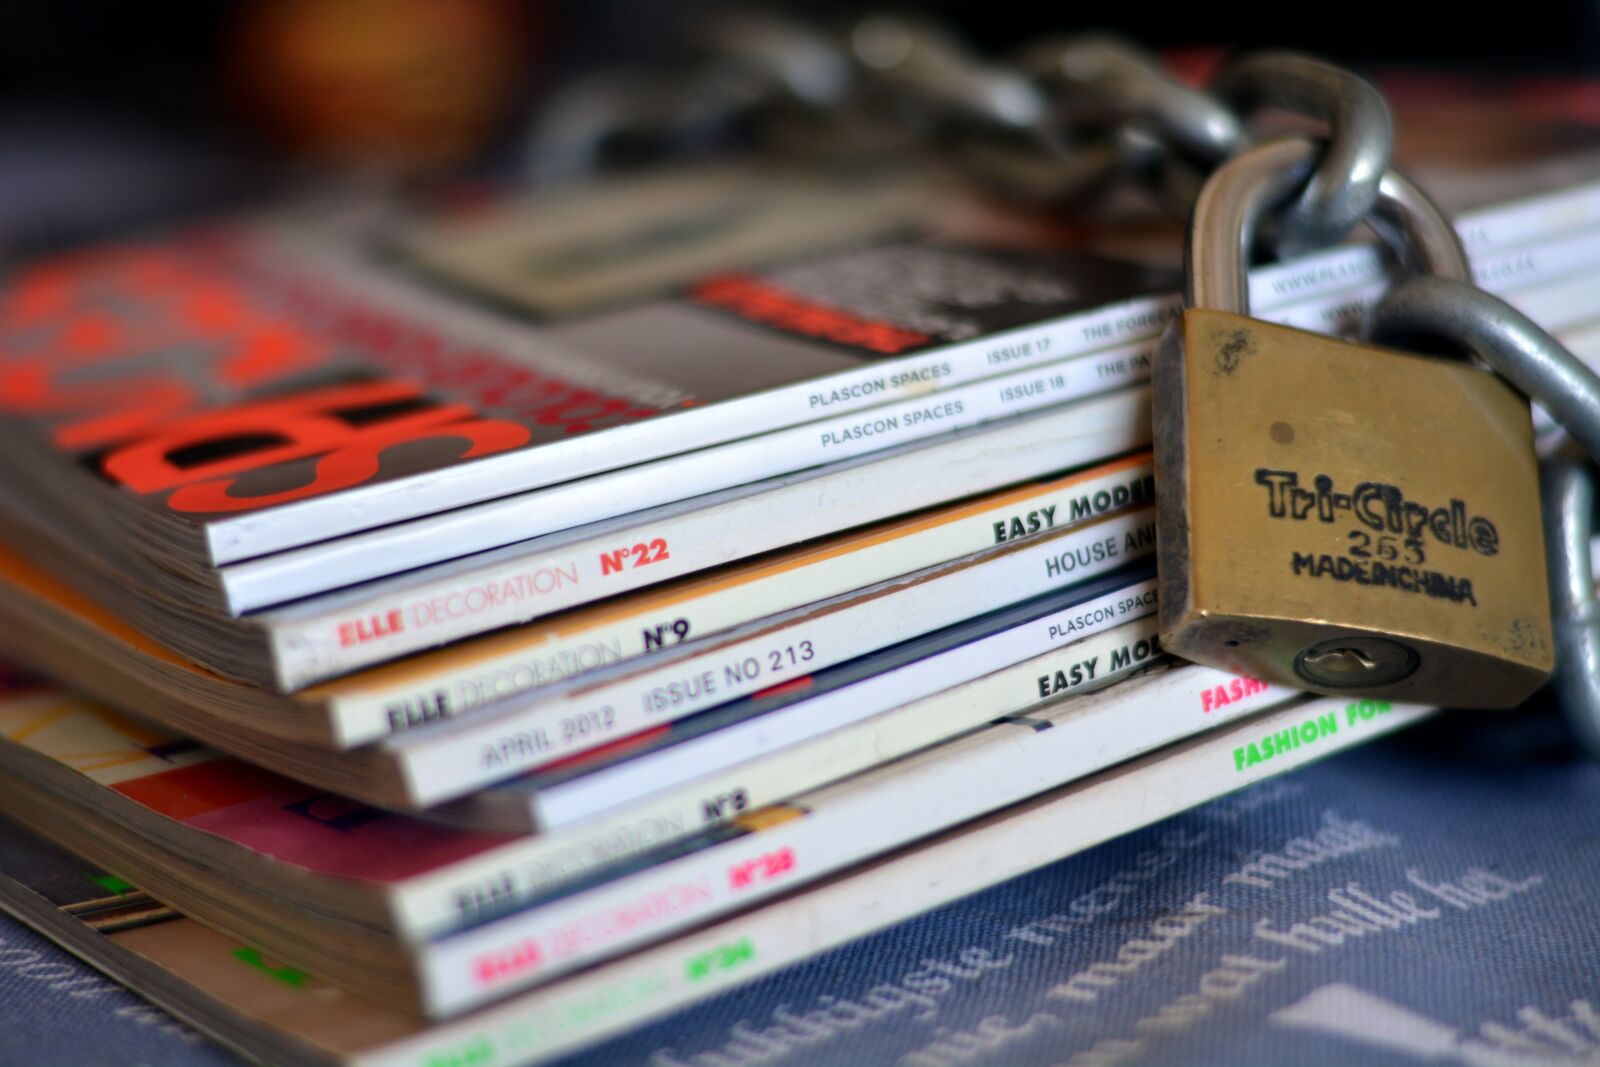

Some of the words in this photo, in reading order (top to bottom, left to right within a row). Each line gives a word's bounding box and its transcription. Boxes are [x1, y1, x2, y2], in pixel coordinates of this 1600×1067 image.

[809, 379, 885, 408] PLASCON
[890, 363, 952, 388] SPACES
[987, 344, 1031, 365] ISSUE
[1036, 338, 1051, 352] 17
[1082, 322, 1111, 341] THE
[821, 417, 898, 447] PLASCON
[903, 401, 964, 426] SPACES
[1000, 380, 1045, 402] ISSUE
[1050, 375, 1066, 389] 18
[1096, 360, 1126, 379] THE
[1253, 467, 1500, 557] Tri-Circle
[337, 609, 404, 648] ELLE
[412, 561, 579, 629] DECORATION
[387, 689, 453, 731] ELLE
[460, 638, 622, 706] DECORATION
[992, 503, 1057, 545] EASY
[1048, 605, 1115, 640] PLASCON
[482, 730, 554, 769] APRIL
[561, 704, 617, 742] 2012
[641, 670, 718, 714] ISSUE
[723, 657, 761, 686] NO
[768, 639, 815, 672] 213
[1045, 537, 1119, 578] HOUSE
[1037, 656, 1099, 698] EASY
[1232, 711, 1338, 772] FASHION
